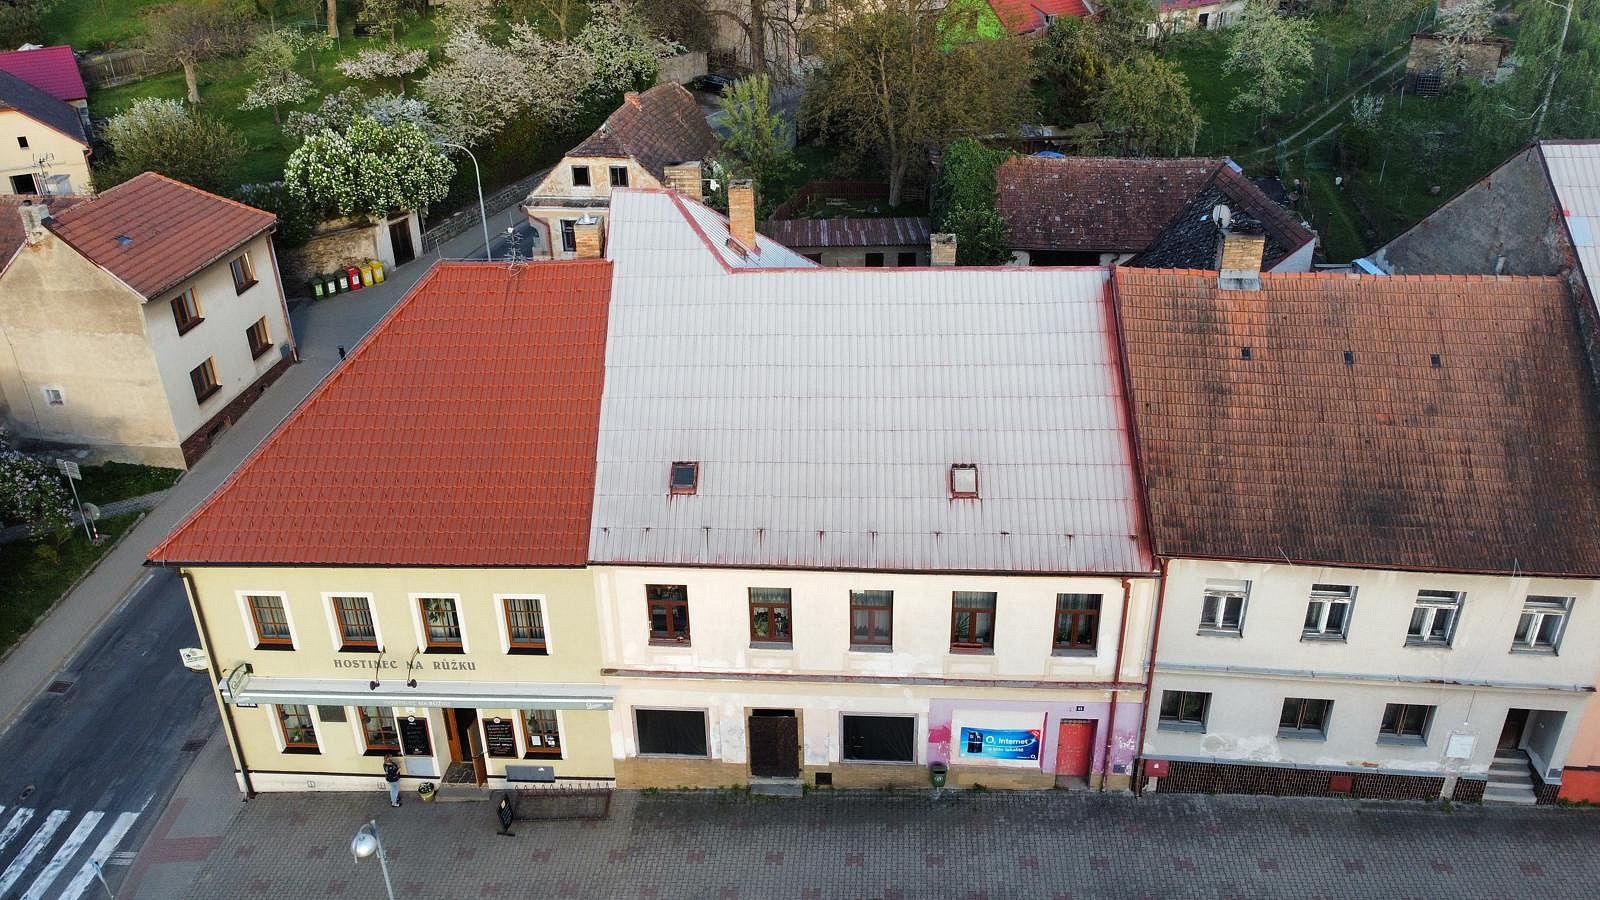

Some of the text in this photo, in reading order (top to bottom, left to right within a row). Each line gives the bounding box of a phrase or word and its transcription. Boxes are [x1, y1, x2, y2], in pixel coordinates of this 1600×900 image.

[334, 659, 398, 669] HOSTINEC
[406, 660, 424, 670] NA
[998, 737, 1028, 745] Internet
